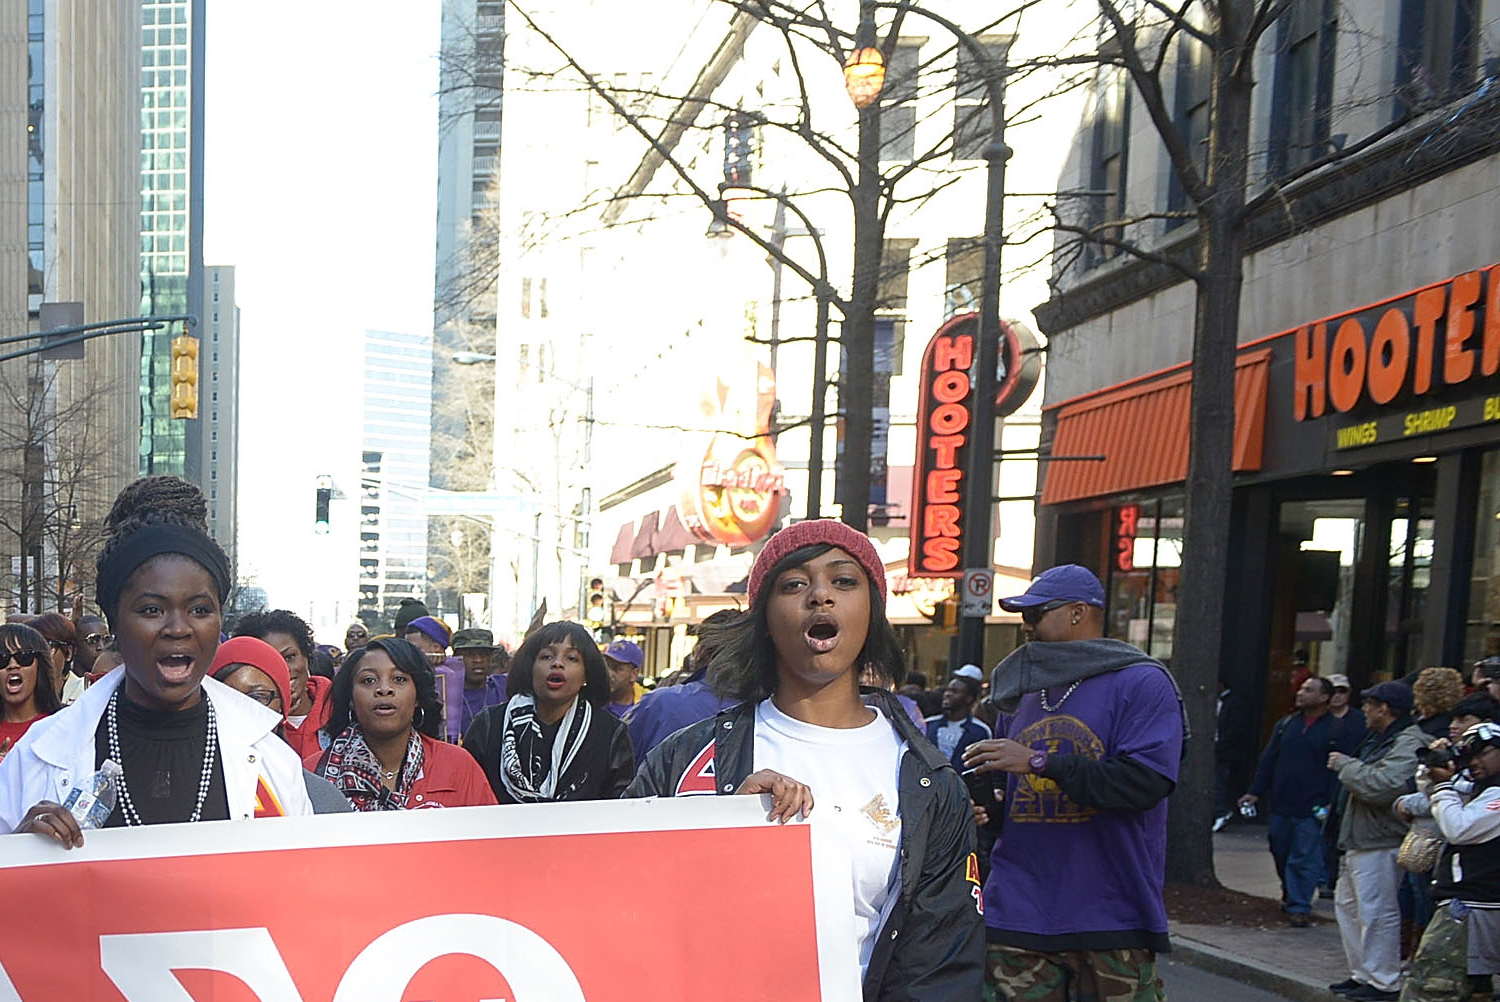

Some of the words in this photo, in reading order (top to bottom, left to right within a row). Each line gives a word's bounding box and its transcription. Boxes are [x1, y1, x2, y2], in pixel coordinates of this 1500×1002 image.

[922, 334, 972, 572] HOOTERS
[1337, 421, 1378, 449] WINGS
[1403, 406, 1457, 436] SHRIMP
